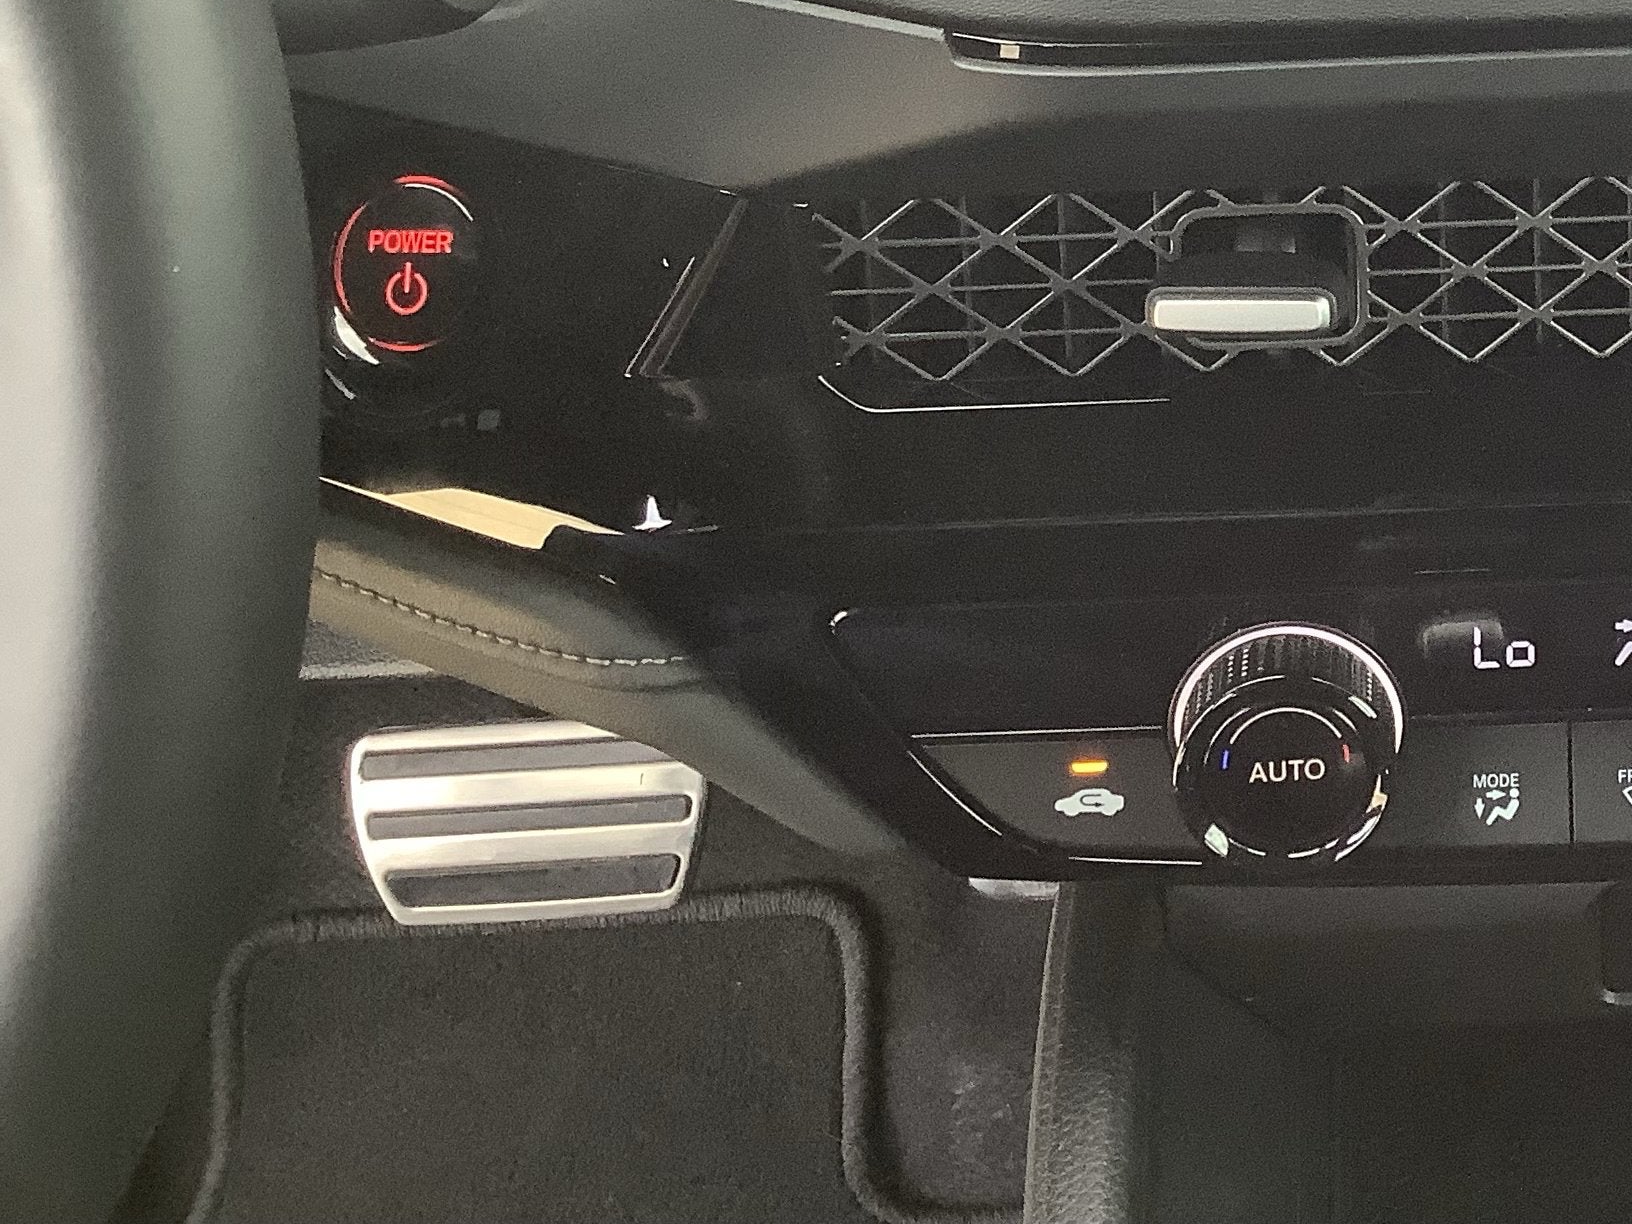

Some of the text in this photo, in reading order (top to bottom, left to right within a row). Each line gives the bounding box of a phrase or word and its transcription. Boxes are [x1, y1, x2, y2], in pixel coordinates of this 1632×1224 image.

[368, 229, 454, 254] POWER
[1473, 627, 1536, 669] Lo
[1248, 758, 1326, 784] AUTO
[1473, 773, 1519, 789] MODE
